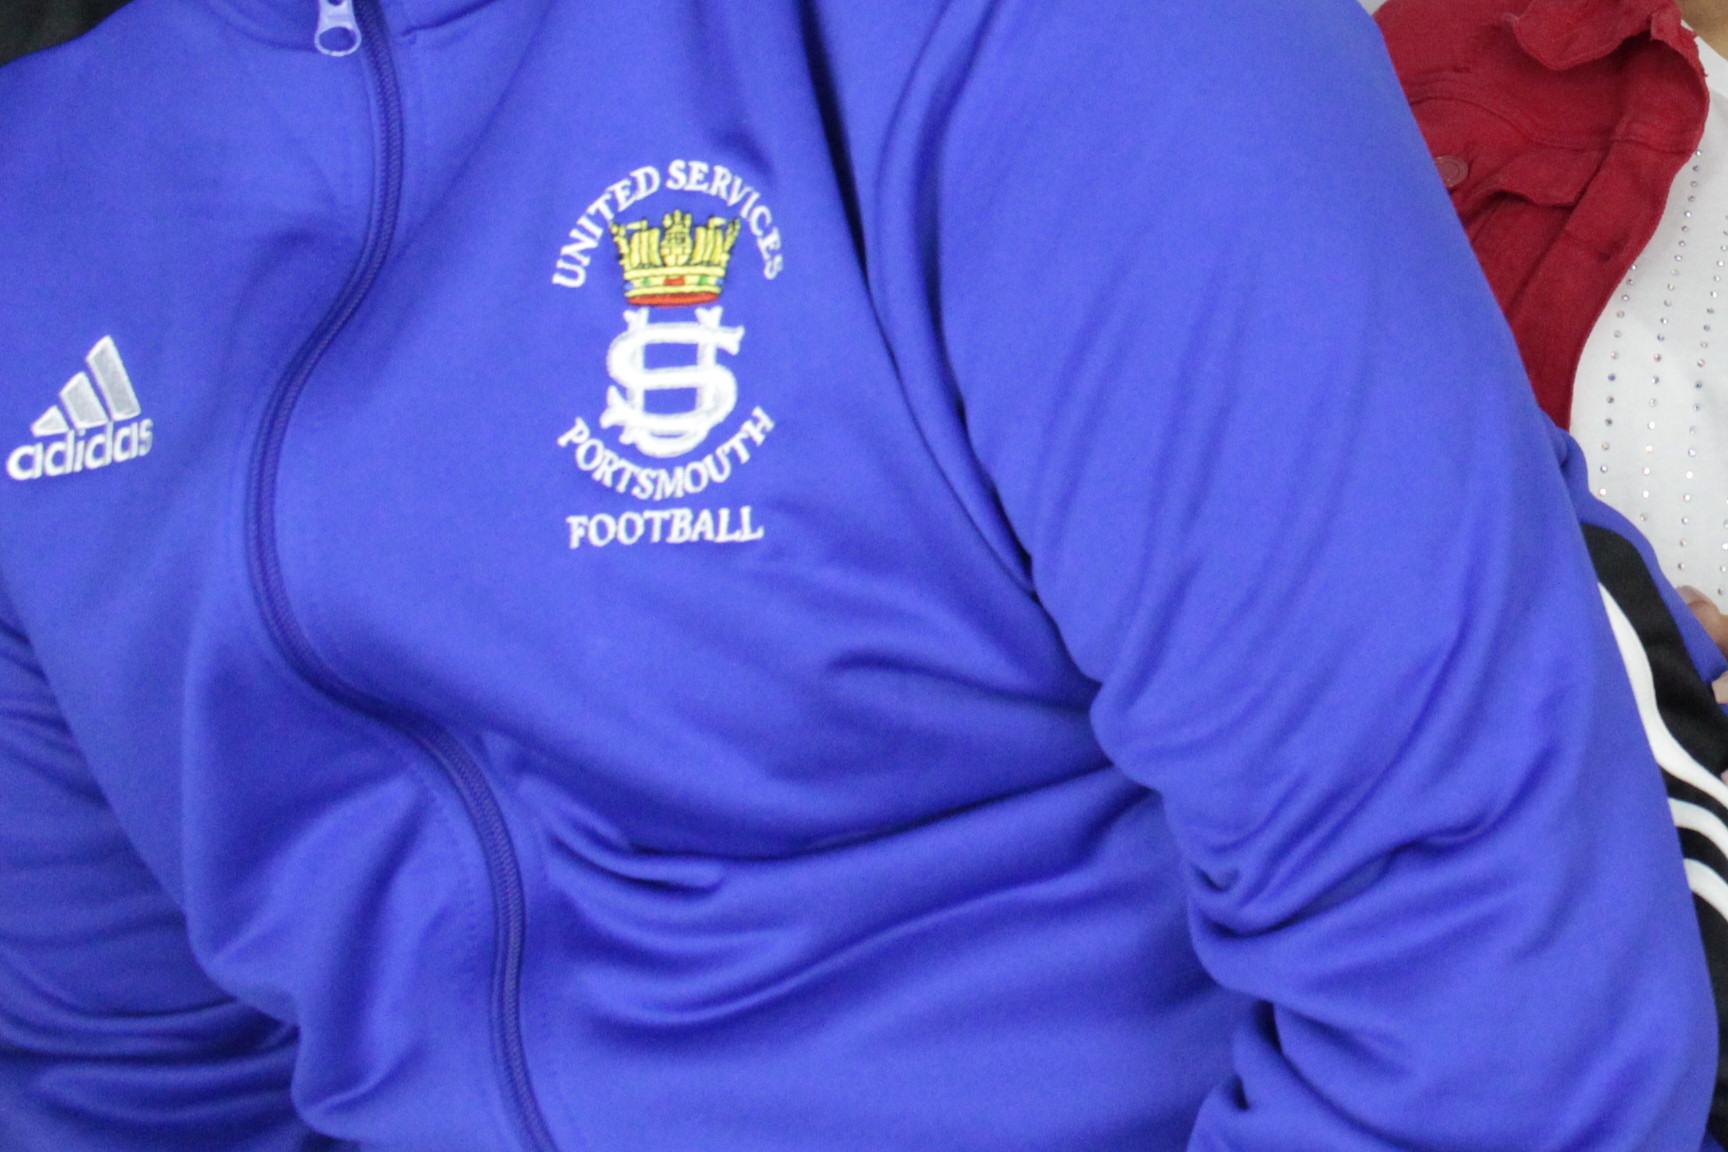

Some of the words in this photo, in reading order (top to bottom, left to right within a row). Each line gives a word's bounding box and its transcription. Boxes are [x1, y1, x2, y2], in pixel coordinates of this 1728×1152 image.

[551, 165, 661, 288] UNITED
[665, 159, 784, 280] SERVICES
[6, 418, 154, 481] adidas
[557, 406, 775, 501] PORTSMOUTH
[565, 505, 765, 549] FOOTBALL
